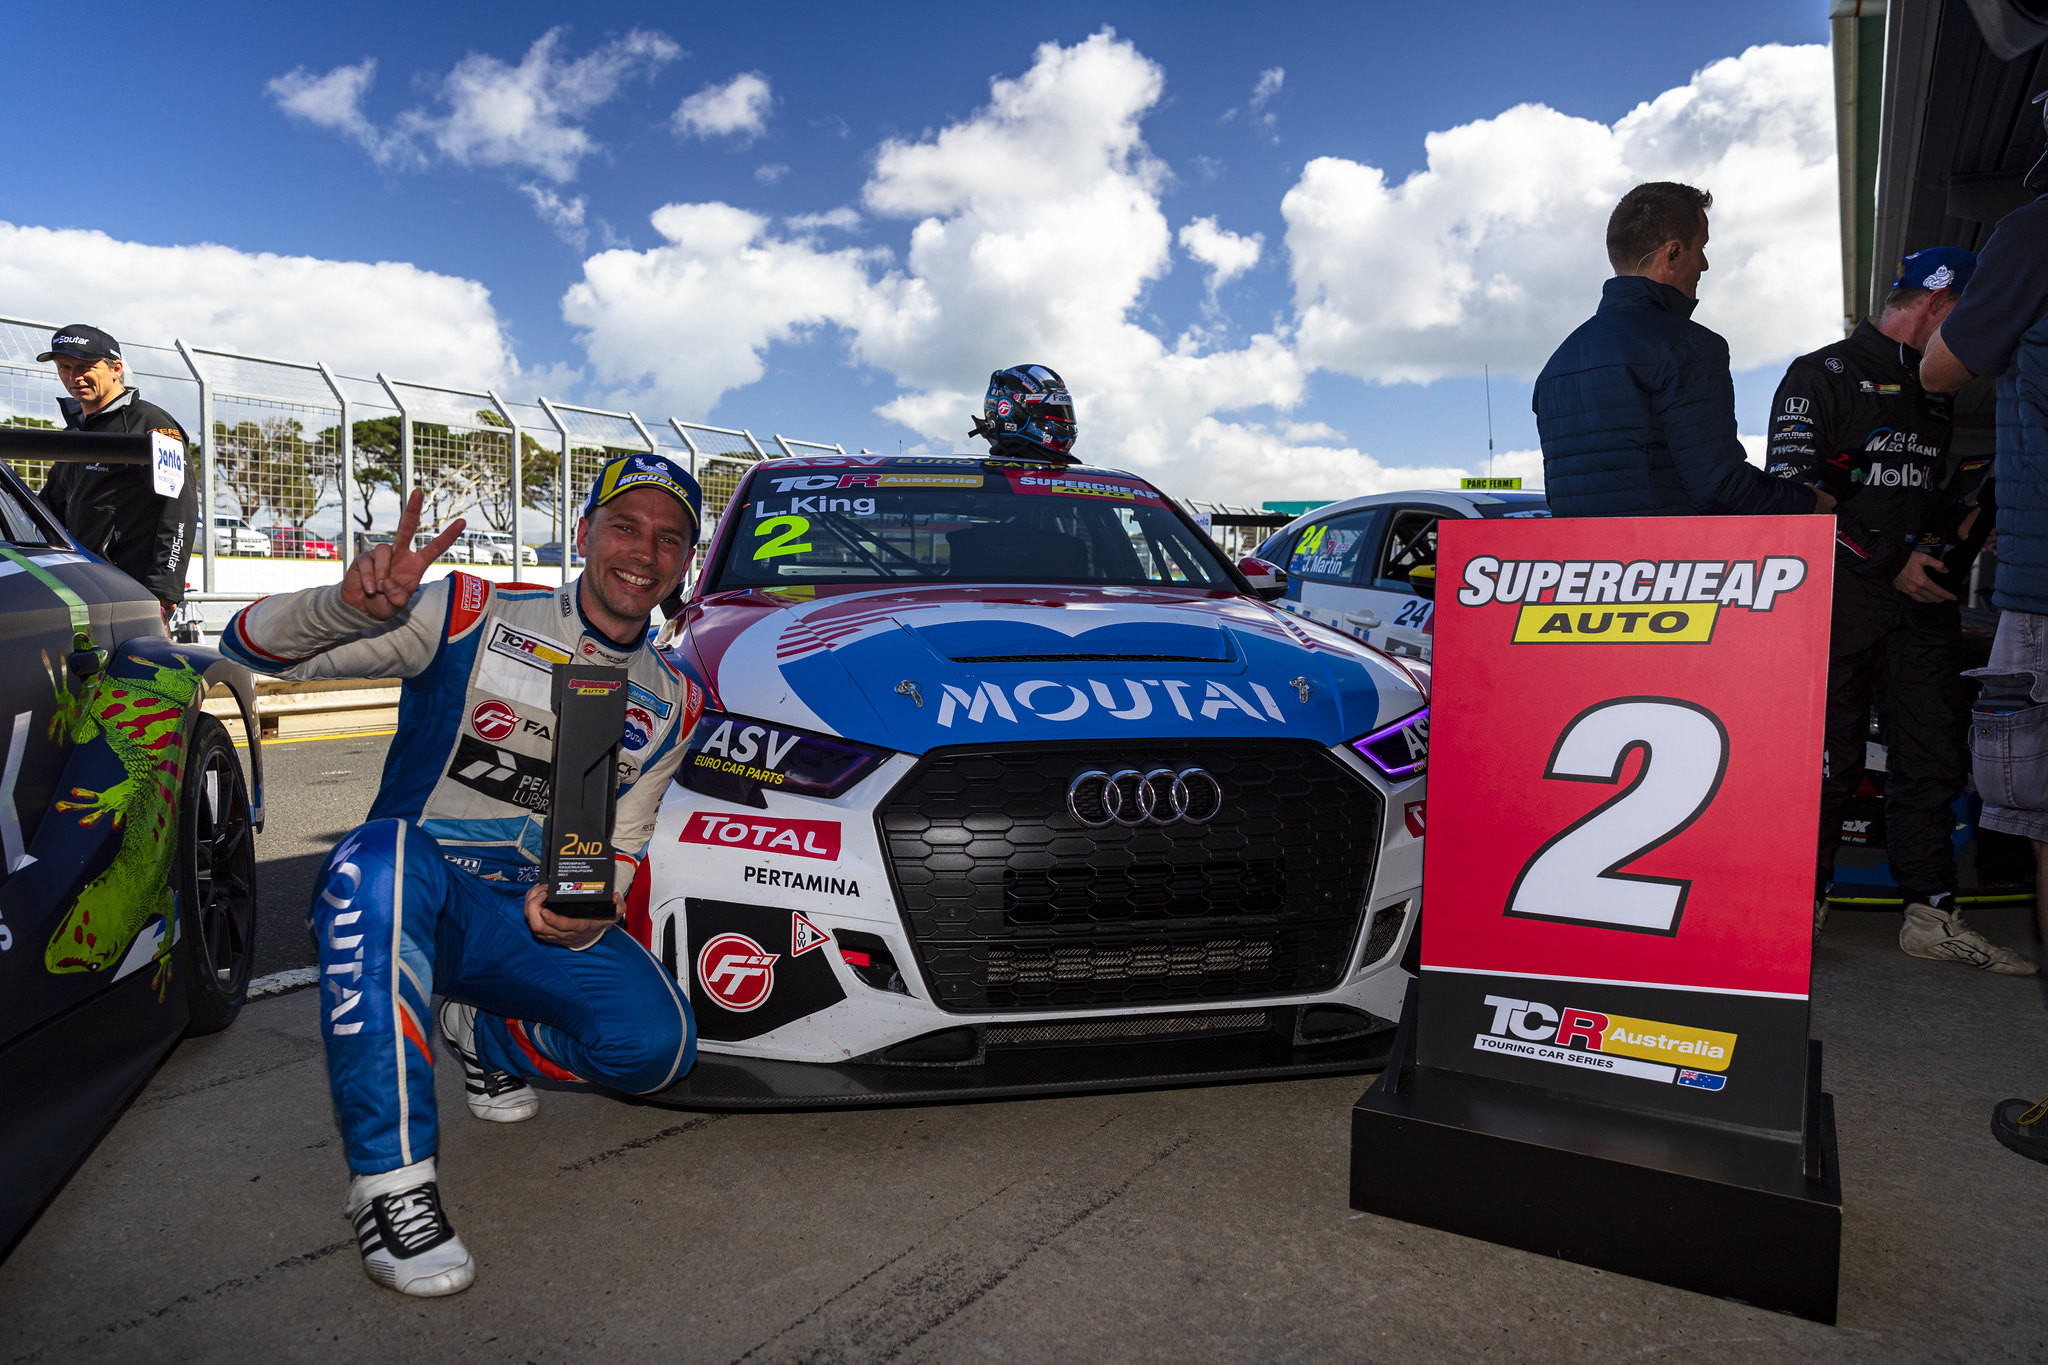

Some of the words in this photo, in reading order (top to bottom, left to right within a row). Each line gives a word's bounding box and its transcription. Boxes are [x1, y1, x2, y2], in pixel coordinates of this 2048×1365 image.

[1776, 415, 1815, 425] HONDA
[767, 456, 888, 469] ASV
[896, 457, 976, 466] EURO
[618, 474, 688, 498] MICHELIN
[770, 474, 883, 493] TCR
[884, 476, 978, 484] Australia
[1019, 476, 1161, 499] SUPERCHEAP
[1062, 487, 1125, 497] AUTO
[1466, 479, 1488, 488] PARC
[1489, 479, 1514, 488] FERME
[753, 515, 812, 560] 2
[1295, 525, 1328, 555] 24
[1301, 556, 1310, 573] J.
[1310, 556, 1343, 575] Martin
[1458, 556, 1807, 611] SUPERCHEAP
[1393, 600, 1432, 629] 24
[1538, 611, 1690, 634] AUTO
[501, 630, 538, 654] TCR
[568, 679, 622, 691] SUPERCHEAP
[937, 678, 1287, 728] MOUTAI
[701, 720, 801, 771] ASV
[1401, 716, 1430, 760] AS
[694, 755, 722, 770] EURO
[722, 761, 745, 776] CAR
[745, 766, 785, 785] PARTS
[1506, 698, 1727, 936] 2
[559, 833, 604, 856] 2ND
[558, 881, 583, 891] TCR
[744, 865, 861, 898] PERTAMINA
[796, 923, 807, 948] TOW
[1484, 994, 1611, 1051] TCR
[1609, 1028, 1725, 1060] Australia
[1480, 1038, 1536, 1056] TOURING
[1538, 1047, 1565, 1061] CAR
[1567, 1053, 1614, 1070] SERIES
